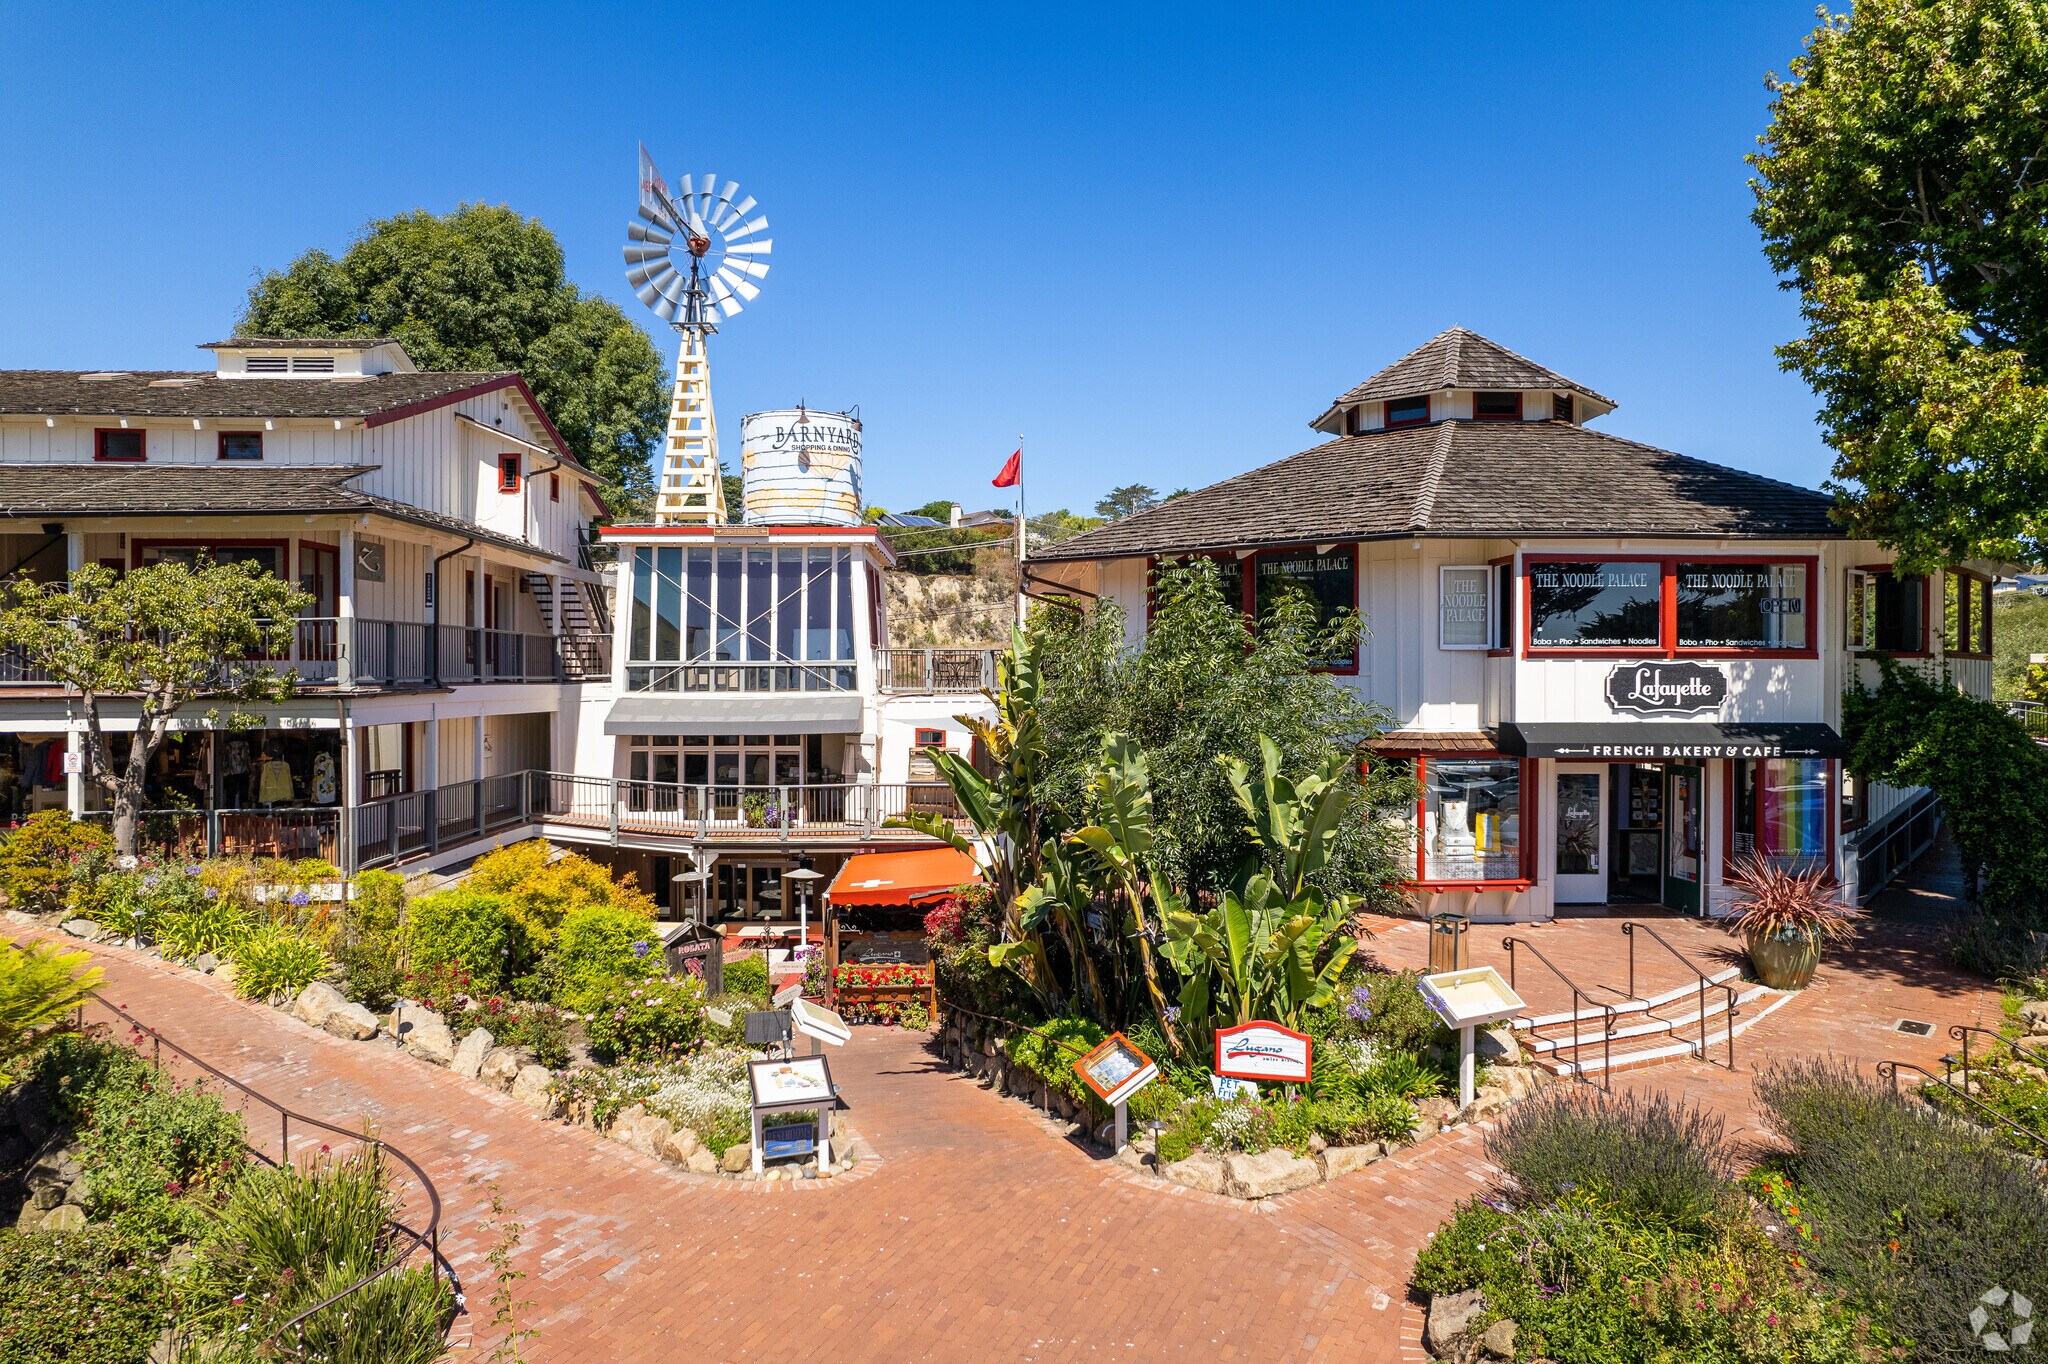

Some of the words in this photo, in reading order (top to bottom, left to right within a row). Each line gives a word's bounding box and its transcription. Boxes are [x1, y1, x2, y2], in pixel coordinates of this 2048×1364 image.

[772, 424, 860, 453] BARNYARD
[833, 445, 850, 453] DINING
[1261, 562, 1279, 575] THE
[1281, 559, 1314, 574] NOODLE
[1316, 556, 1349, 572] PALACE
[1454, 579, 1477, 593] THE
[1536, 573, 1559, 588] THE
[1562, 573, 1604, 588] NOODLE
[1608, 573, 1647, 588] PALACE
[1685, 573, 1708, 588] THE
[1712, 573, 1753, 588] NOODLE
[1756, 573, 1796, 588] PALACE
[1444, 593, 1486, 608] NOODLE
[1763, 599, 1799, 612] OPEN
[1446, 608, 1486, 622] PALACE
[1533, 637, 1552, 645] Boba
[1579, 637, 1621, 645] Sandwiches
[1628, 637, 1657, 645] Noodles
[1679, 638, 1698, 646] Boba
[1725, 638, 1766, 646] Sandwiches
[1628, 668, 1711, 706] Lafayette
[1593, 746, 1654, 757] FRENCH
[1663, 746, 1721, 757] BAKERY
[1725, 746, 1738, 757] &
[1742, 746, 1781, 758] CAFE
[1566, 807, 1590, 818] Lafayette
[1226, 1037, 1283, 1058] Lugano
[1220, 1077, 1240, 1090] PET
[767, 1126, 811, 1141] RESTROOMS
